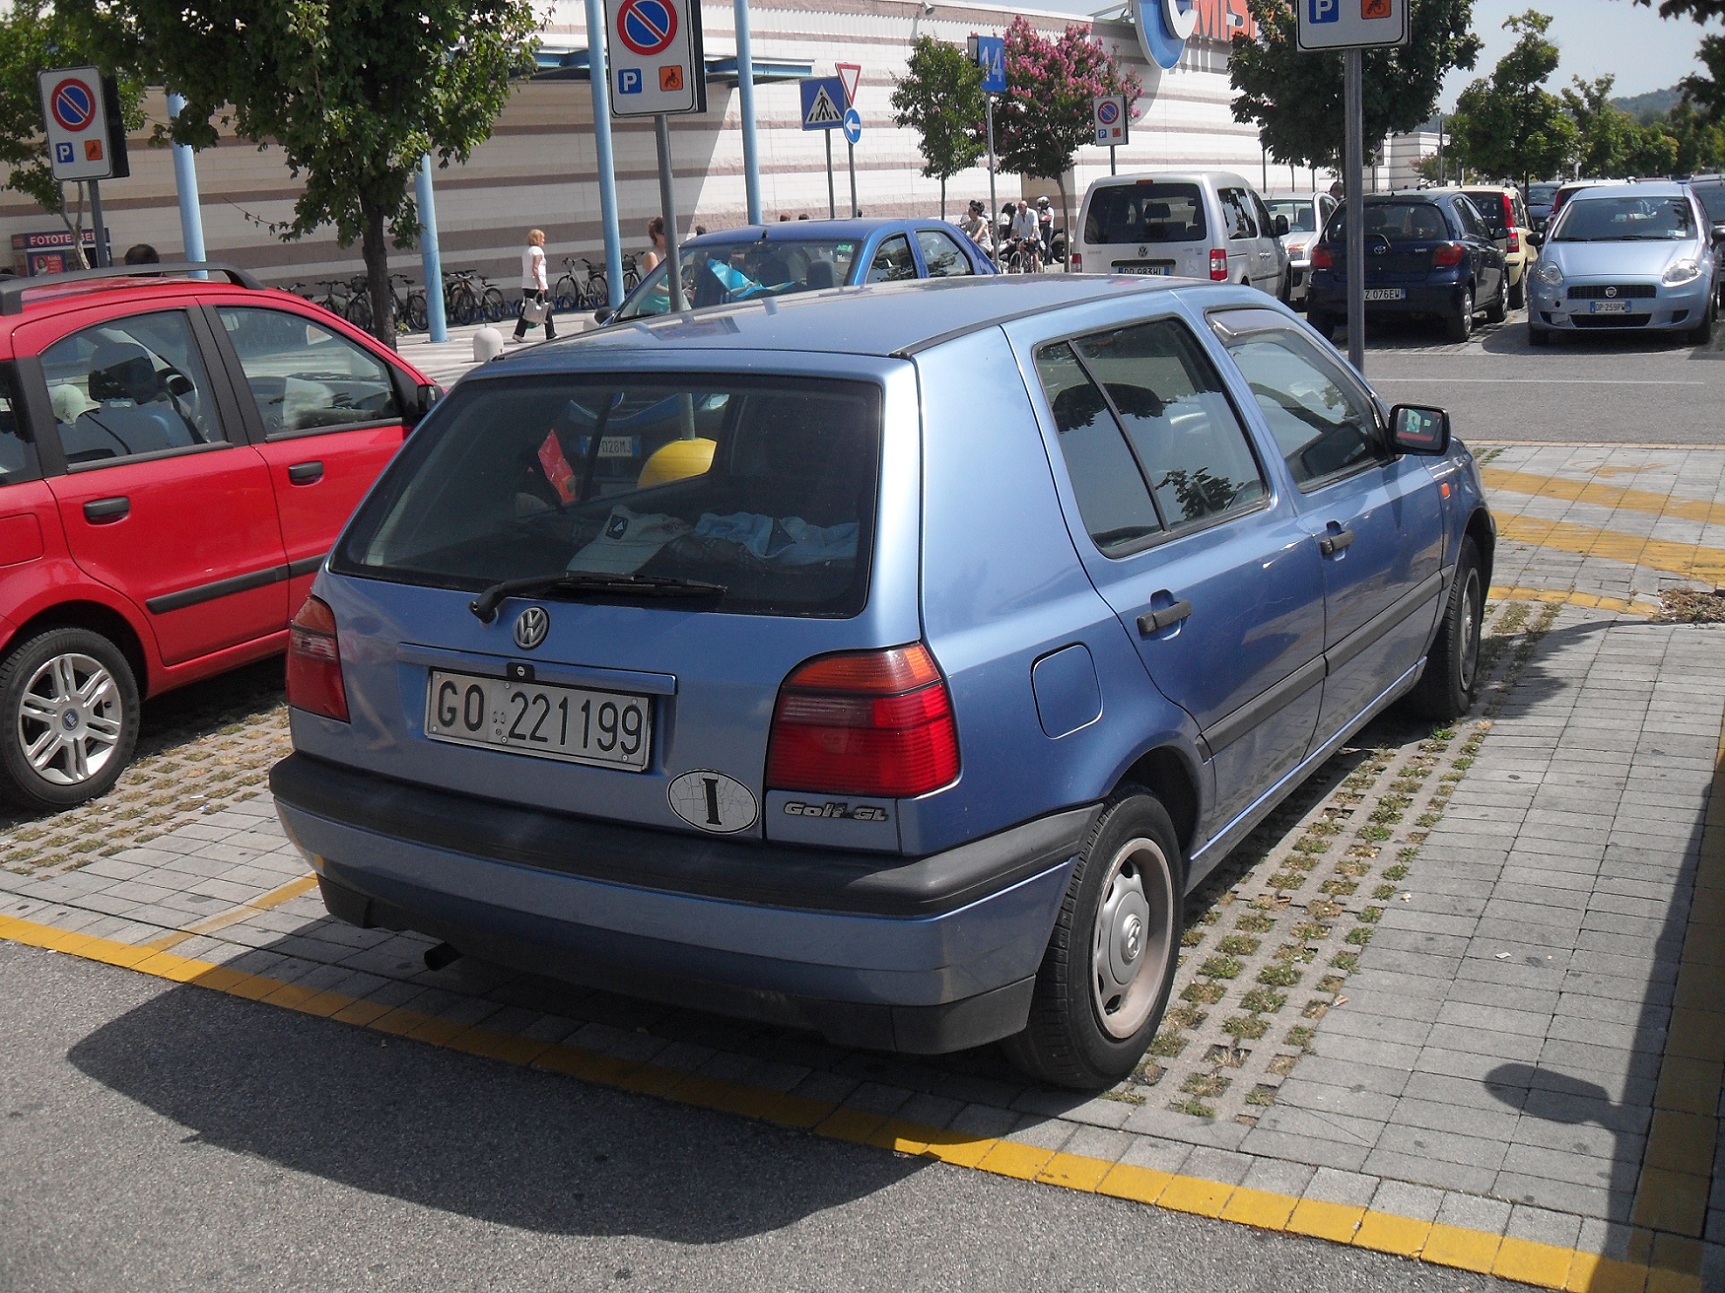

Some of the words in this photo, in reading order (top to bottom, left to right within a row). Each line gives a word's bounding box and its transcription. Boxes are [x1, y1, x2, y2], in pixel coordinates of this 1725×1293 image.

[981, 46, 1003, 82] 14
[623, 72, 637, 91] P
[59, 145, 70, 161] P
[437, 680, 485, 732] GO
[498, 691, 643, 756] 221199
[702, 777, 722, 826] I
[784, 801, 848, 819] Golf
[852, 805, 889, 822] GL
